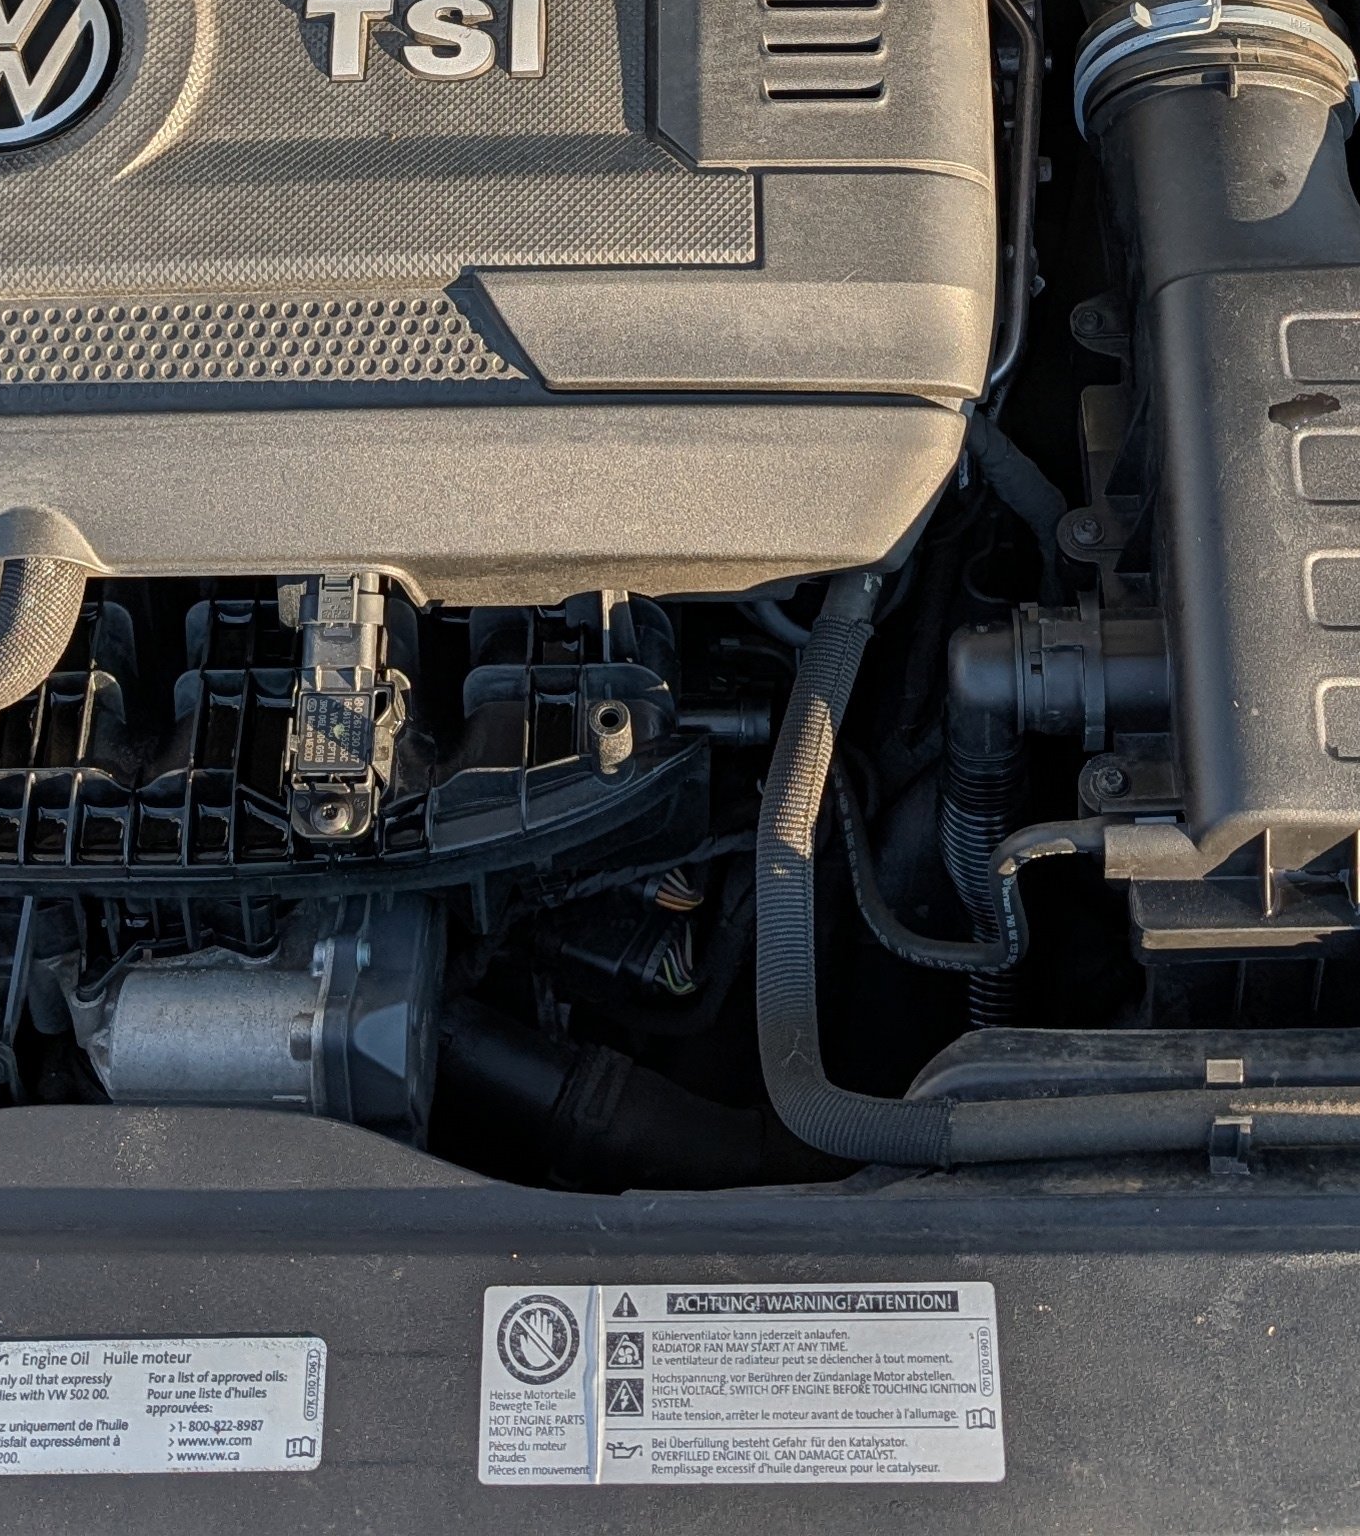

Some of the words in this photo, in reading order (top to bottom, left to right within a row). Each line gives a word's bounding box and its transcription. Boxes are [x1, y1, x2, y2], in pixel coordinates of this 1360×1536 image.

[674, 1296, 760, 1311] ACHTUNG!
[765, 1295, 851, 1311] WARNING!
[856, 1294, 952, 1310] ATTENTION!
[652, 1331, 731, 1341] Kühlerventilator
[733, 1330, 757, 1340] kann
[759, 1330, 802, 1342] jederzeit
[804, 1329, 850, 1340] anlaufen.
[652, 1343, 701, 1353] RADIATOR
[704, 1343, 724, 1352] FAN
[726, 1343, 749, 1352] MAY
[751, 1342, 780, 1352] START
[782, 1342, 795, 1352] AT
[797, 1342, 818, 1351] ANY
[820, 1342, 848, 1351] TIME.
[22, 1353, 67, 1369] Engine
[71, 1351, 90, 1365] Oil
[103, 1351, 138, 1365] Huile
[142, 1351, 192, 1364] moteur
[652, 1356, 663, 1365] Le
[664, 1355, 718, 1365] ventilateur
[720, 1355, 733, 1365] de
[735, 1355, 779, 1364] radiateur
[782, 1356, 804, 1367] peut
[820, 1354, 873, 1364] déclencher
[883, 1355, 905, 1364] tout
[907, 1355, 952, 1363] moment.
[19, 1374, 33, 1385] oil
[36, 1373, 58, 1385] that
[61, 1373, 112, 1389] expressly
[149, 1372, 166, 1383] For
[168, 1374, 175, 1383] a
[178, 1371, 194, 1382] list
[197, 1371, 209, 1382] of
[211, 1370, 263, 1385] approved
[265, 1370, 287, 1382] oils:
[730, 1375, 746, 1383] vor
[748, 1373, 793, 1382] Berühren
[795, 1372, 811, 1382] der
[813, 1372, 871, 1384] Zündanlage
[874, 1372, 905, 1381] Motor
[906, 1371, 955, 1381] abstellen.
[20, 1389, 44, 1401] with
[48, 1389, 67, 1400] VW
[70, 1389, 89, 1400] 502
[92, 1389, 109, 1400] 00.
[147, 1389, 173, 1399] Pour
[176, 1389, 196, 1399] une
[199, 1387, 222, 1399] liste
[224, 1387, 267, 1399] d'huiles
[490, 1390, 521, 1400] Heisse
[524, 1389, 576, 1399] Motorteile
[652, 1386, 678, 1395] HIGH
[730, 1385, 768, 1395] SWITCH
[771, 1385, 790, 1394] OFF
[792, 1385, 830, 1394] ENGINE
[833, 1384, 870, 1394] BEFORE
[873, 1384, 927, 1394] TOUCHING
[930, 1384, 977, 1393] IGNITION
[490, 1401, 532, 1412] Bewegte
[535, 1401, 557, 1410] Teile
[652, 1398, 694, 1408] SYSTEM.
[146, 1402, 213, 1417] approuvées:
[652, 1411, 683, 1421] Haute
[725, 1410, 759, 1420] arrêter
[761, 1410, 770, 1420] le
[772, 1411, 809, 1420] moteur
[811, 1411, 841, 1419] avant
[843, 1409, 853, 1419] de
[854, 1409, 894, 1419] toucher
[489, 1416, 511, 1425] HOT
[513, 1415, 552, 1425] ENGINE
[555, 1415, 585, 1424] PARTS
[9, 1420, 75, 1434] uniquement
[78, 1419, 93, 1431] de
[96, 1419, 128, 1431] l'huile
[489, 1427, 532, 1436] MOVING
[536, 1427, 565, 1436] PARTS
[30, 1435, 110, 1450] expressément
[113, 1435, 120, 1446] à
[178, 1436, 252, 1446] www.vw.com
[489, 1441, 516, 1451] Pièces
[518, 1441, 531, 1451] du
[533, 1442, 567, 1451] moteur
[652, 1438, 667, 1449] Bei
[669, 1436, 729, 1451] Überfüllung
[732, 1438, 770, 1448] besteht
[772, 1438, 807, 1448] Gefahr
[811, 1437, 825, 1447] für
[827, 1437, 846, 1447] den
[849, 1437, 908, 1450] Katalysator.
[177, 1451, 240, 1461] www.vw.ca
[488, 1453, 526, 1462] chaudes
[652, 1451, 710, 1461] OVERFILLED
[712, 1451, 751, 1461] ENGINE
[753, 1451, 770, 1460] OIL
[774, 1450, 796, 1460] CAN
[799, 1450, 844, 1460] DAMAGE
[847, 1450, 897, 1460] CATALYST.
[488, 1465, 516, 1475] Pièces
[532, 1466, 590, 1475] mouvement
[652, 1464, 713, 1477] Remplissage
[716, 1464, 755, 1473] excessif
[758, 1464, 791, 1473] d'huile
[793, 1463, 847, 1476] dangereux
[850, 1465, 873, 1475] pour
[876, 1463, 886, 1473] le
[887, 1463, 940, 1475] catalyseur.
